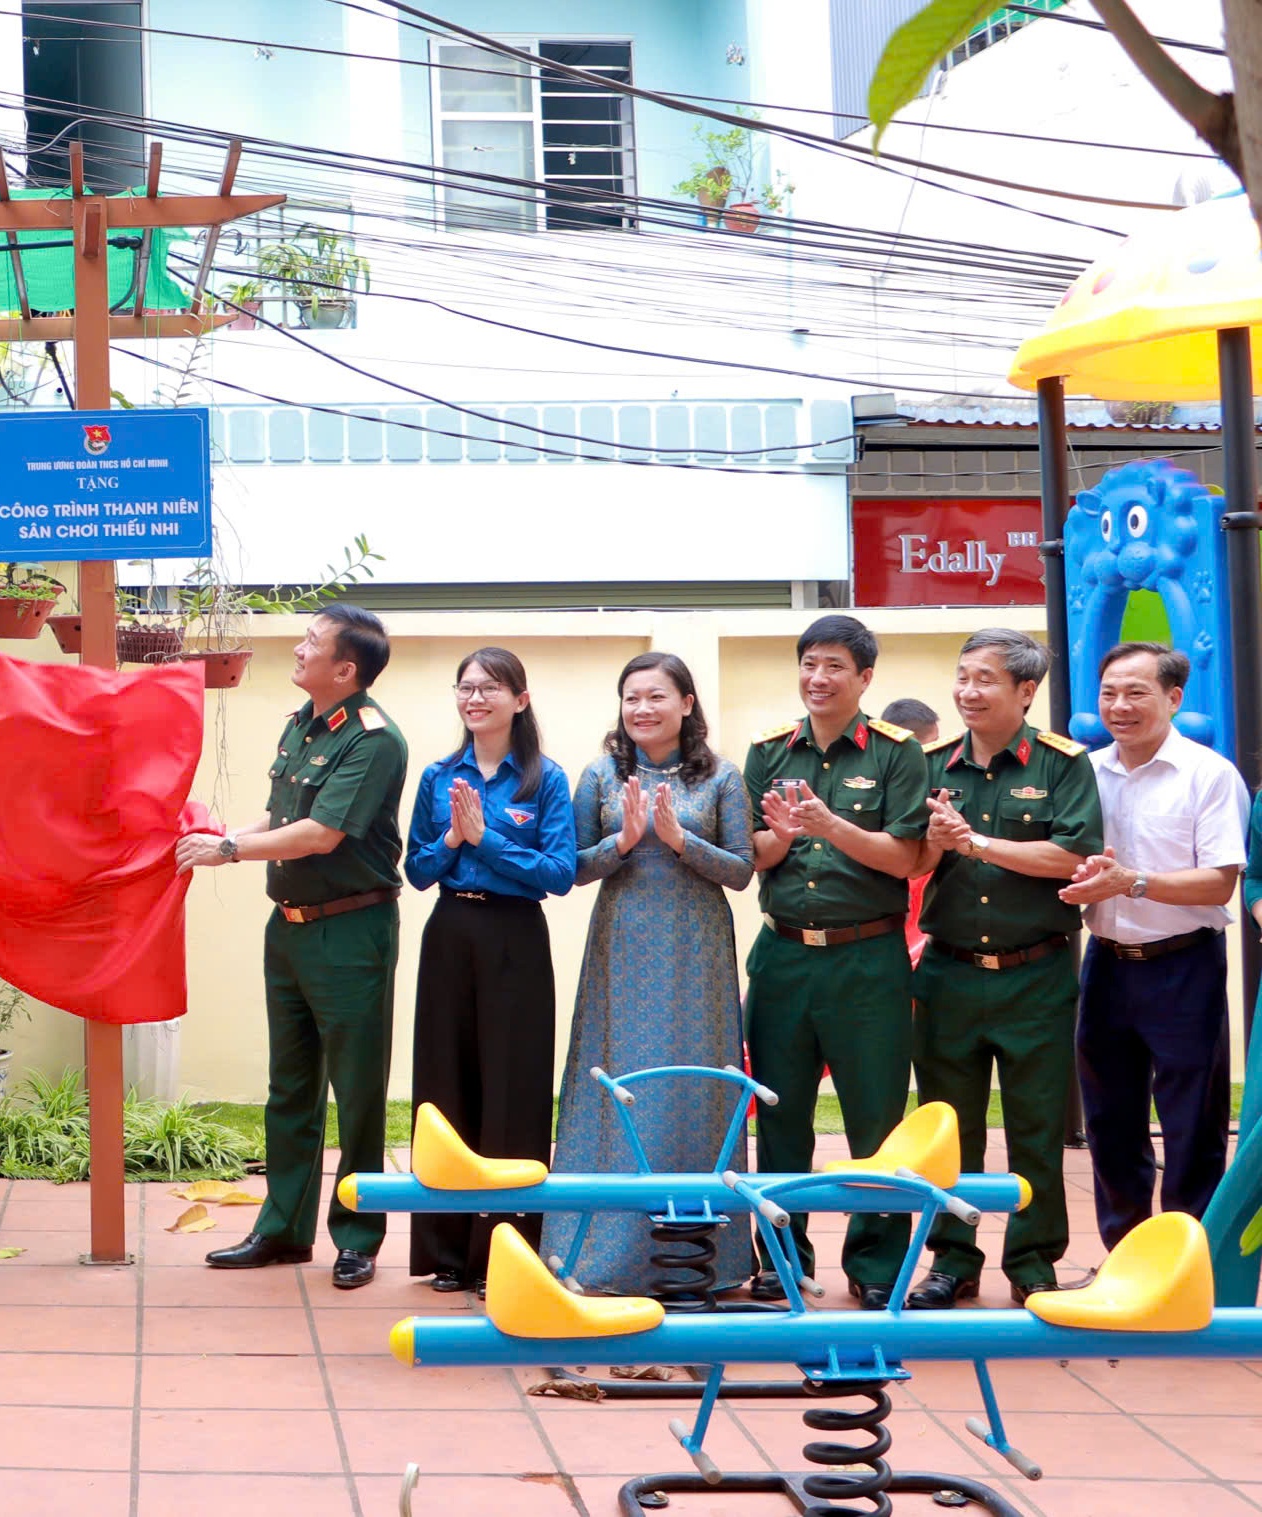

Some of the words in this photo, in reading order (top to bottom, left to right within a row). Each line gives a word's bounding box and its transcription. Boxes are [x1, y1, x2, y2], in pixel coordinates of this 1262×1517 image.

[26, 462, 52, 471] TRUNG
[99, 460, 119, 469] TNCS
[132, 457, 146, 469] CHÍ
[147, 459, 169, 468] MINH
[76, 475, 119, 492] TẶNG
[53, 500, 99, 517] TRÌNH
[103, 502, 158, 516] THANH
[162, 498, 199, 514] NIÊN
[19, 522, 52, 539] SÂN
[56, 523, 99, 538] CHƠI
[102, 518, 146, 537] THIẾU
[151, 522, 179, 536] NHI
[898, 534, 1006, 586] Edally
